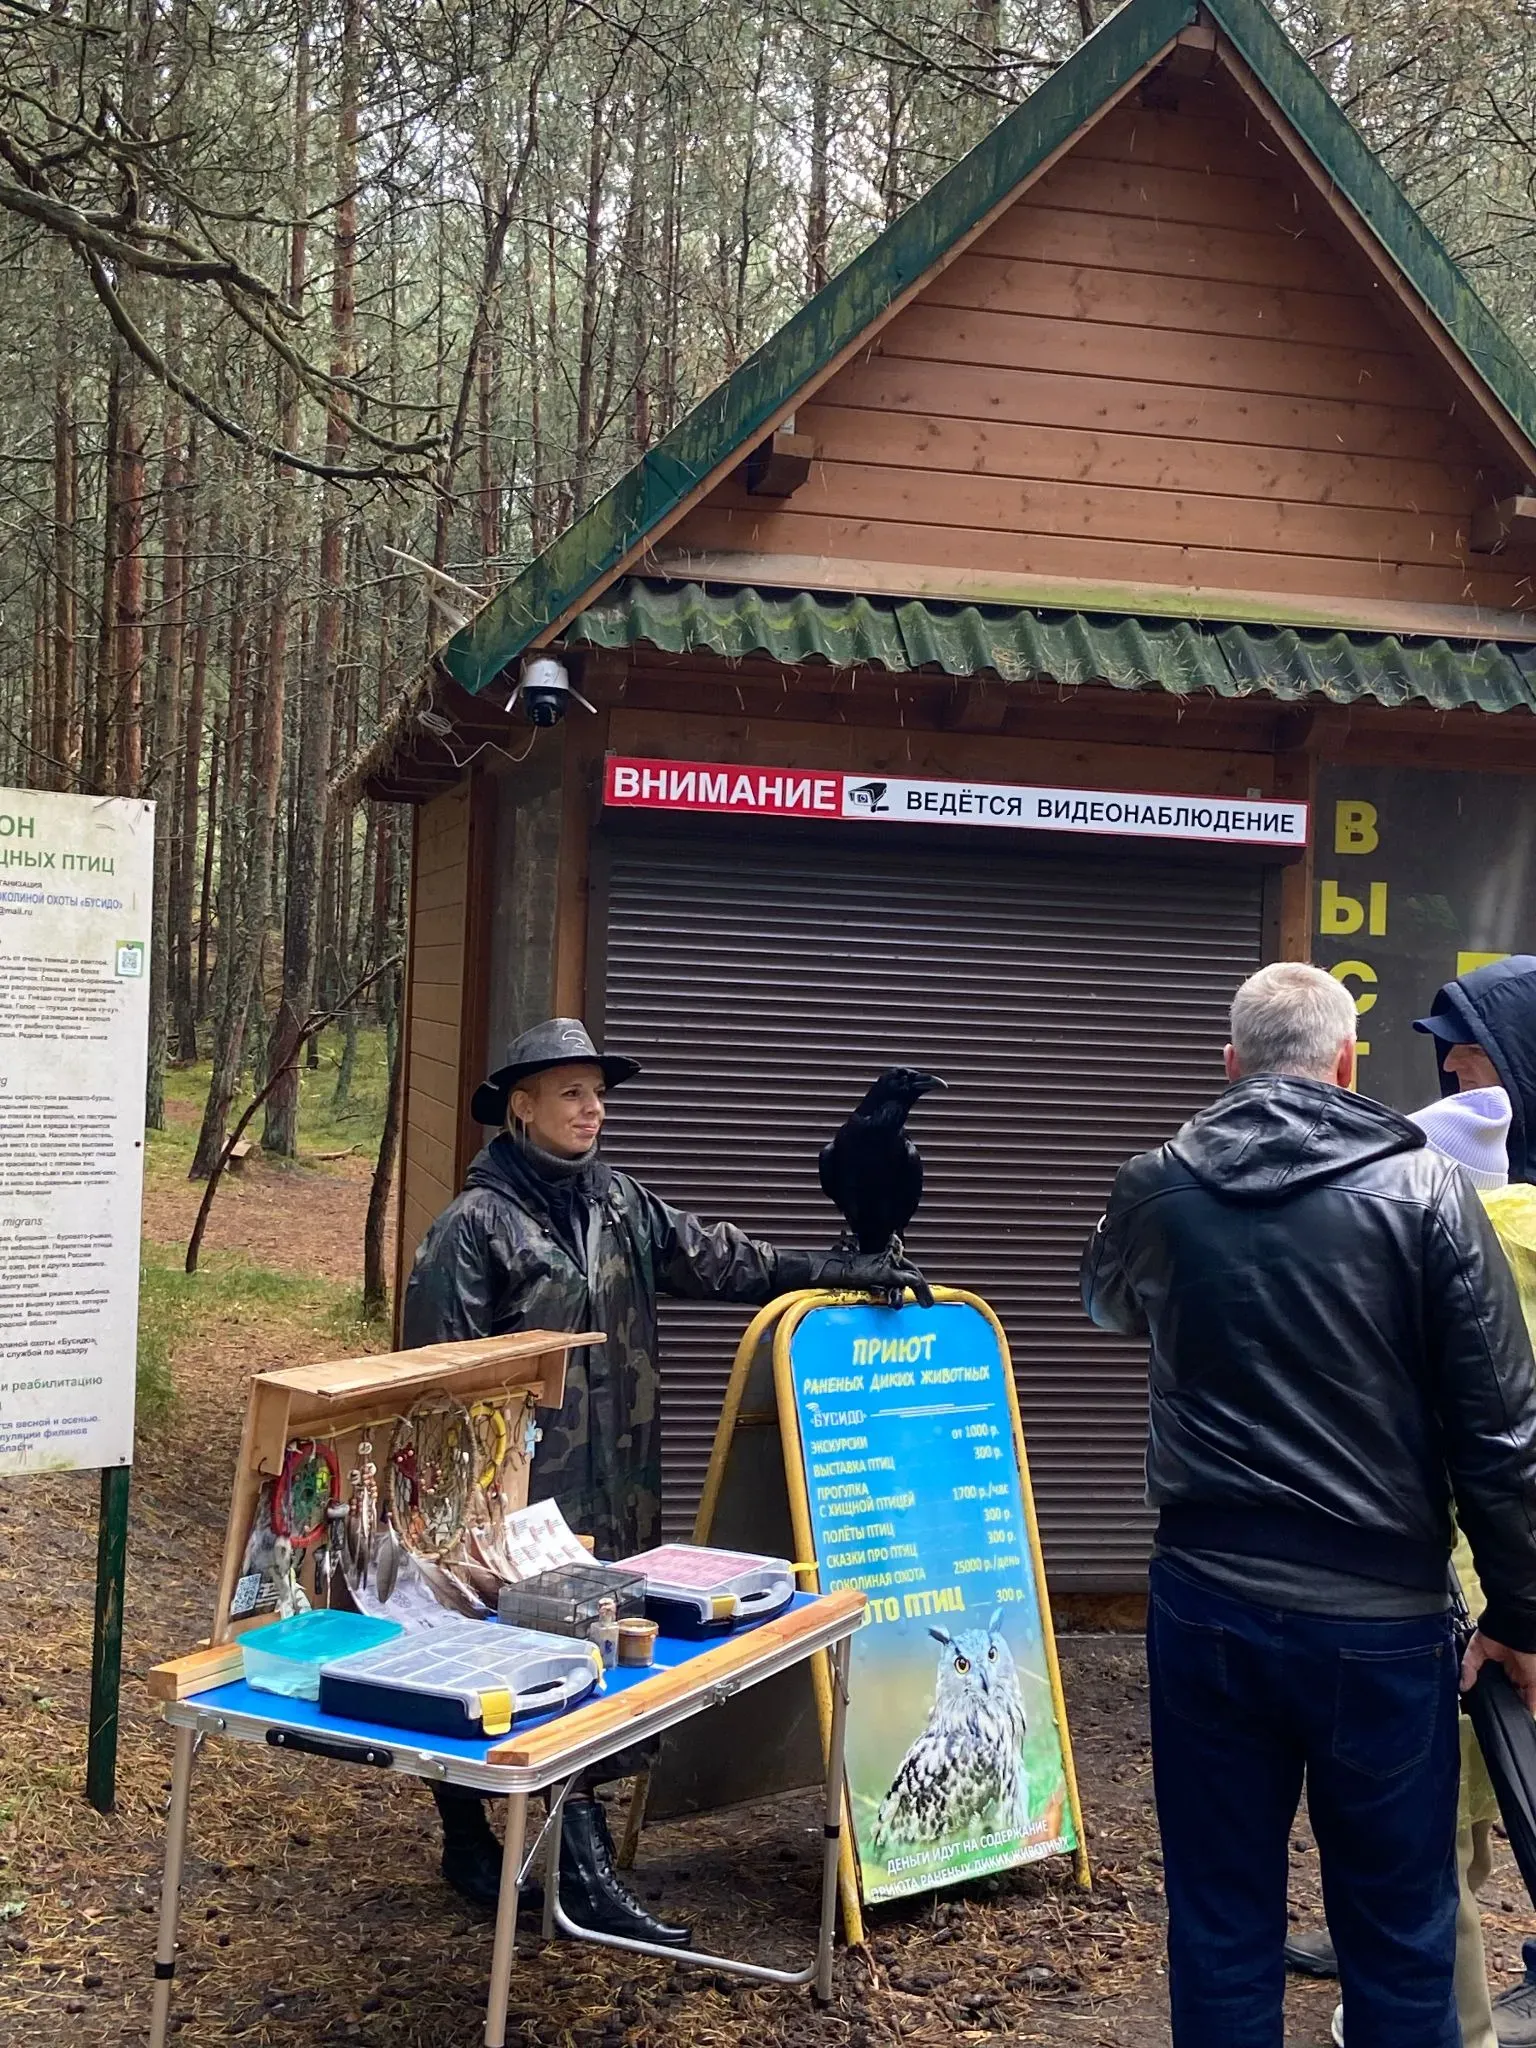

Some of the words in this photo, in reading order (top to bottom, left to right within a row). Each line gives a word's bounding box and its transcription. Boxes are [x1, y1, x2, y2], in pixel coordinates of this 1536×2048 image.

[613, 766, 837, 811] ВНИМАНИЕ
[905, 788, 1023, 818] ВЕДЁТСЯ
[1036, 798, 1295, 834] ВИДЕОНАБЛЮДЕНИЕ
[62, 854, 115, 876] ПТИЦ
[0, 891, 45, 905] КОЛИНОЙ
[47, 895, 79, 907] ОХОТЫ
[3, 1216, 43, 1229] migrans
[852, 1333, 936, 1366] ПРИЮТ
[12, 1376, 103, 1393] реабилитацию
[803, 1375, 864, 1395] РАНЕНЫХ
[869, 1371, 915, 1392] ДИКИХ
[920, 1365, 990, 1385] ЖИВОТНЫХ
[810, 1436, 868, 1455] ЭКСКУРСИИ
[965, 1423, 989, 1438] 1000
[813, 1460, 867, 1478] ВЫСТАВКА
[867, 1456, 896, 1472] ПТИЦ
[817, 1483, 869, 1501] ПРОГУЛКА
[953, 1486, 976, 1501] 1700
[819, 1506, 826, 1518] С
[827, 1498, 875, 1517] ХИЩНОЙ
[876, 1491, 915, 1511] ПТИЦЕЙ
[822, 1525, 865, 1544] ПОЛЁТЫ
[867, 1522, 896, 1539] ПТИЦ
[983, 1507, 1002, 1522] 300
[826, 1551, 865, 1569] СКАЗКИ
[867, 1547, 889, 1563] ПРО
[890, 1544, 918, 1560] ПТИЦ
[986, 1530, 1005, 1545] 300
[829, 1573, 892, 1593] СОКОЛИНАЯ
[894, 1568, 926, 1585] ОХОТА
[953, 1557, 982, 1575] 25000
[902, 1586, 966, 1620] ПТИЦ
[995, 1588, 1014, 1603] 300
[886, 1851, 931, 1877] ДЕНЬГИ
[932, 1841, 961, 1864] ИДУТ
[963, 1840, 979, 1854] НА
[980, 1819, 1049, 1850] СОДЕРЖАНИЕ
